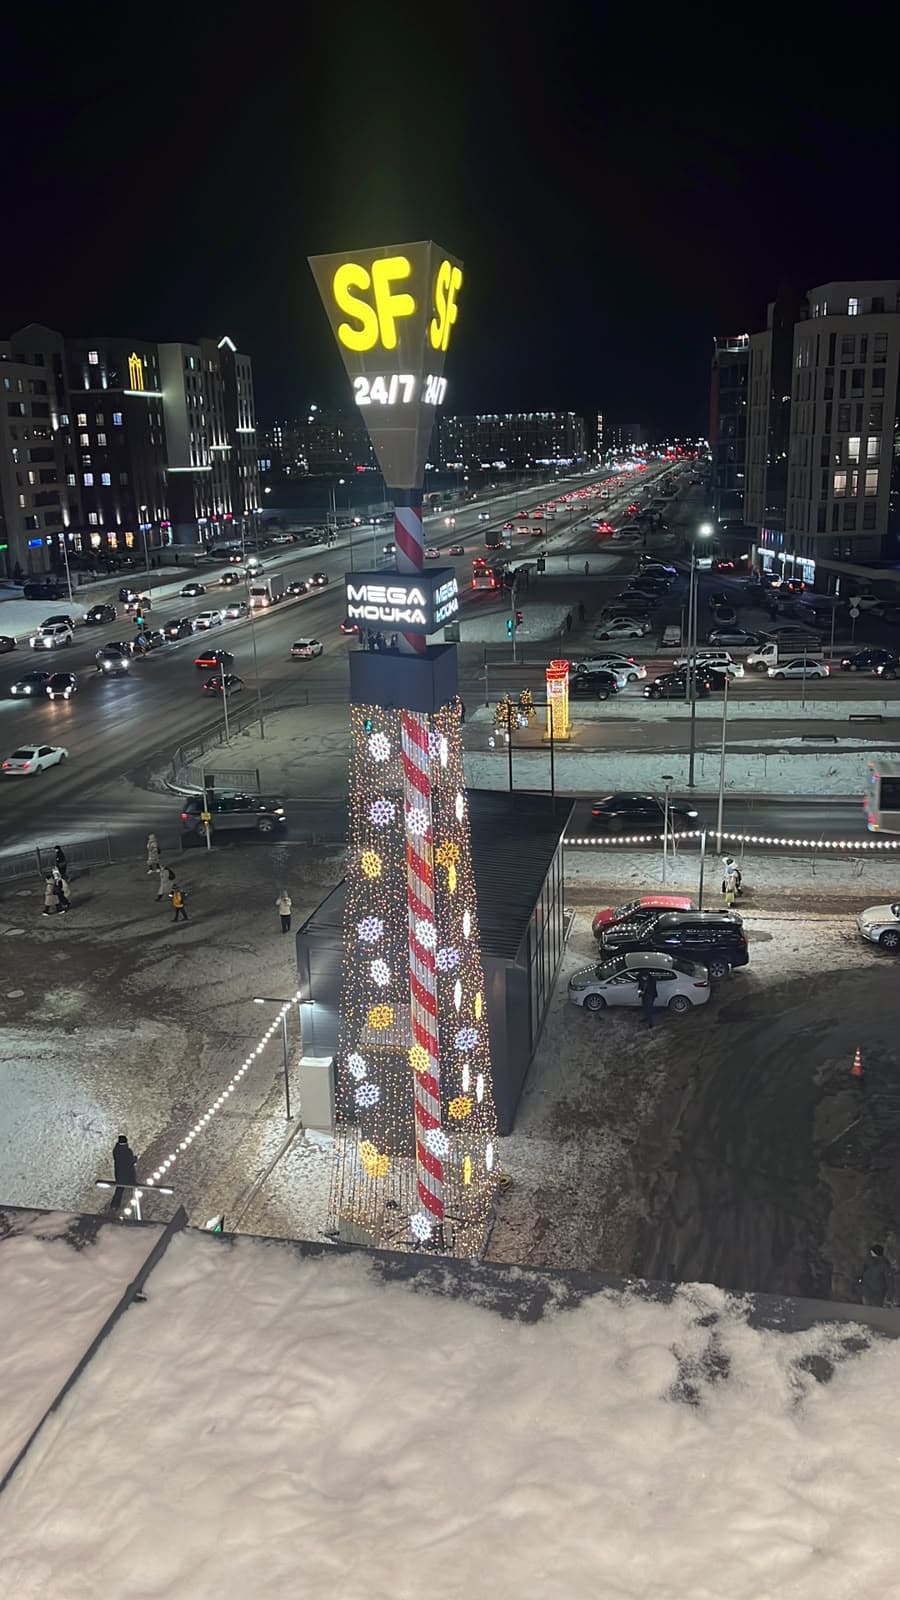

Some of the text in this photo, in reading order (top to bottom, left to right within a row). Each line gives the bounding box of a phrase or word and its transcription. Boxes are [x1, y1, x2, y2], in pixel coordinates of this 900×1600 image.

[333, 256, 415, 351] SF
[430, 260, 462, 351] SF
[353, 374, 415, 405] 24/7
[424, 374, 447, 405] 24/7
[347, 584, 426, 606] MEGA
